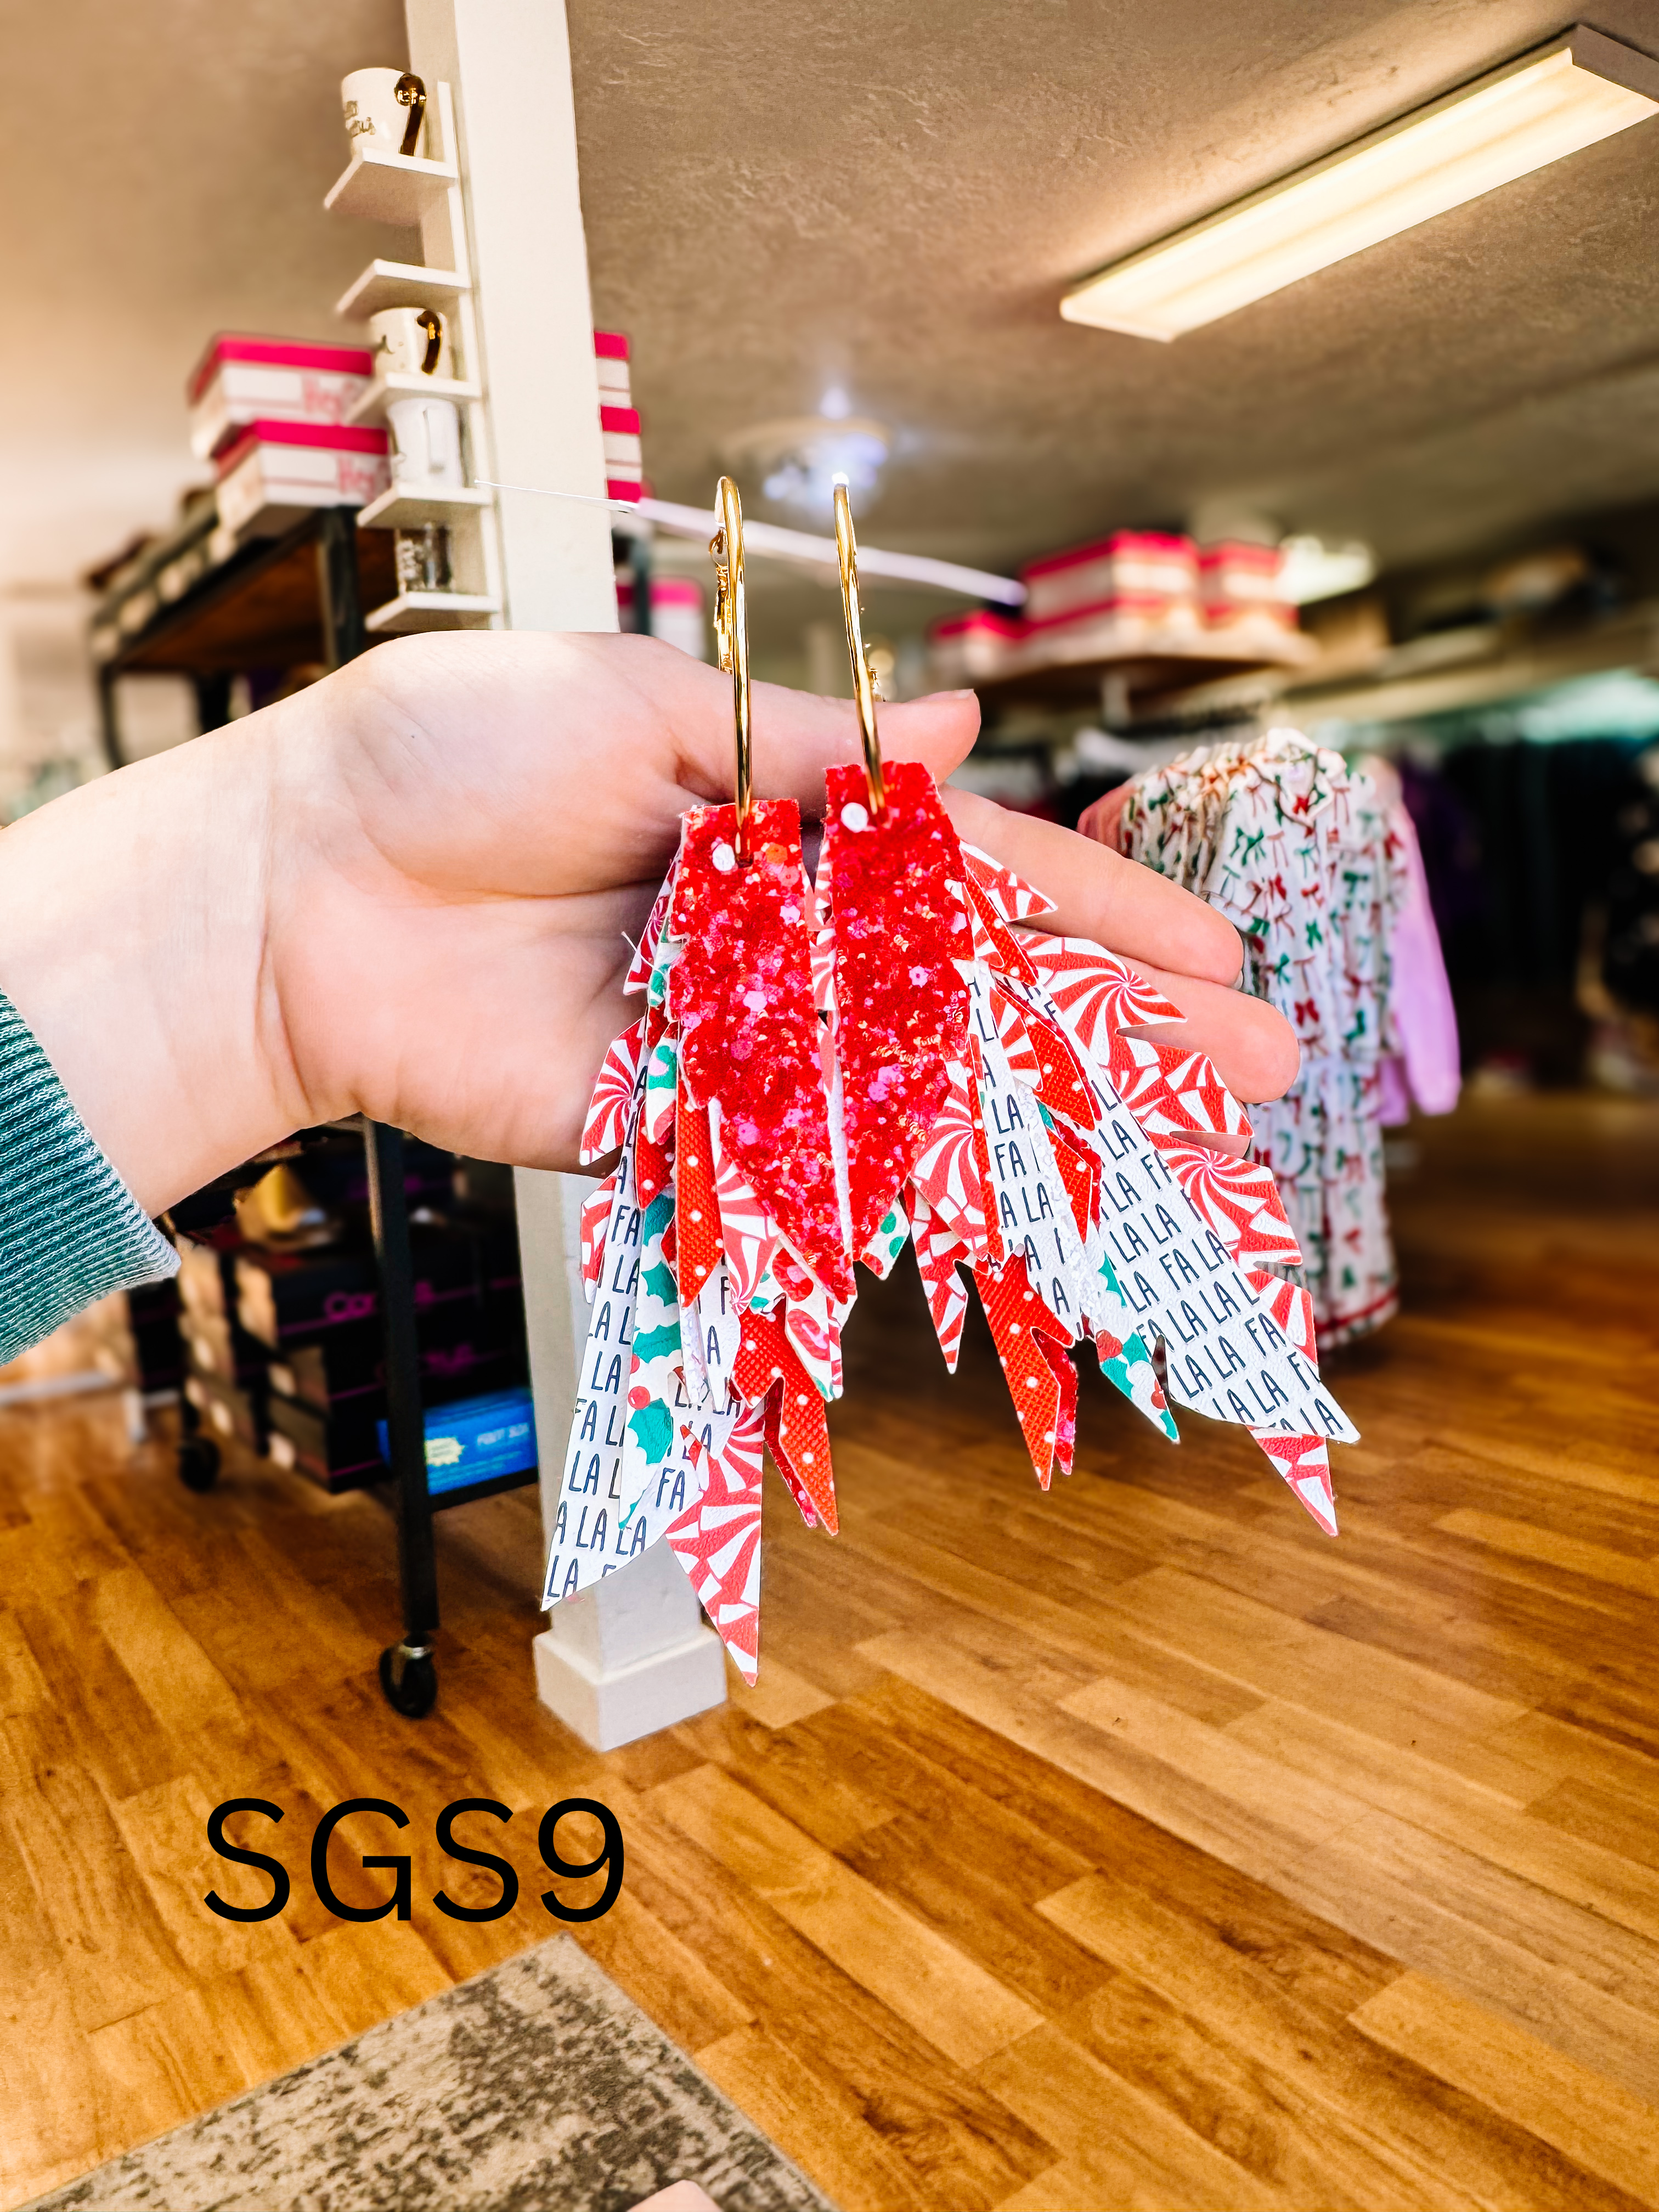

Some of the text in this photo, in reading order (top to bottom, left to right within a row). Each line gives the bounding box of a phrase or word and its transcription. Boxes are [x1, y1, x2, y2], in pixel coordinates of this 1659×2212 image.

[991, 1094, 1025, 1134] LA
[994, 1141, 1028, 1182] FA
[1098, 1119, 1138, 1161] LA
[1021, 1182, 1054, 1223] LA
[1102, 1171, 1142, 1214] LA
[611, 1205, 641, 1248] FA
[1109, 1222, 1150, 1264] LA
[1140, 1203, 1182, 1245] LA
[1119, 1229, 1233, 1314] LA FA LA
[1166, 1300, 1208, 1344] LA
[1199, 1281, 1242, 1325] LA
[591, 1350, 622, 1395] LA
[1170, 1312, 1287, 1399] LA LA FA
[1245, 1369, 1289, 1415] LA
[568, 1450, 600, 1496] LA
[656, 1467, 686, 1512] FA
[575, 1505, 607, 1551] LA
[547, 1555, 579, 1599] LA
